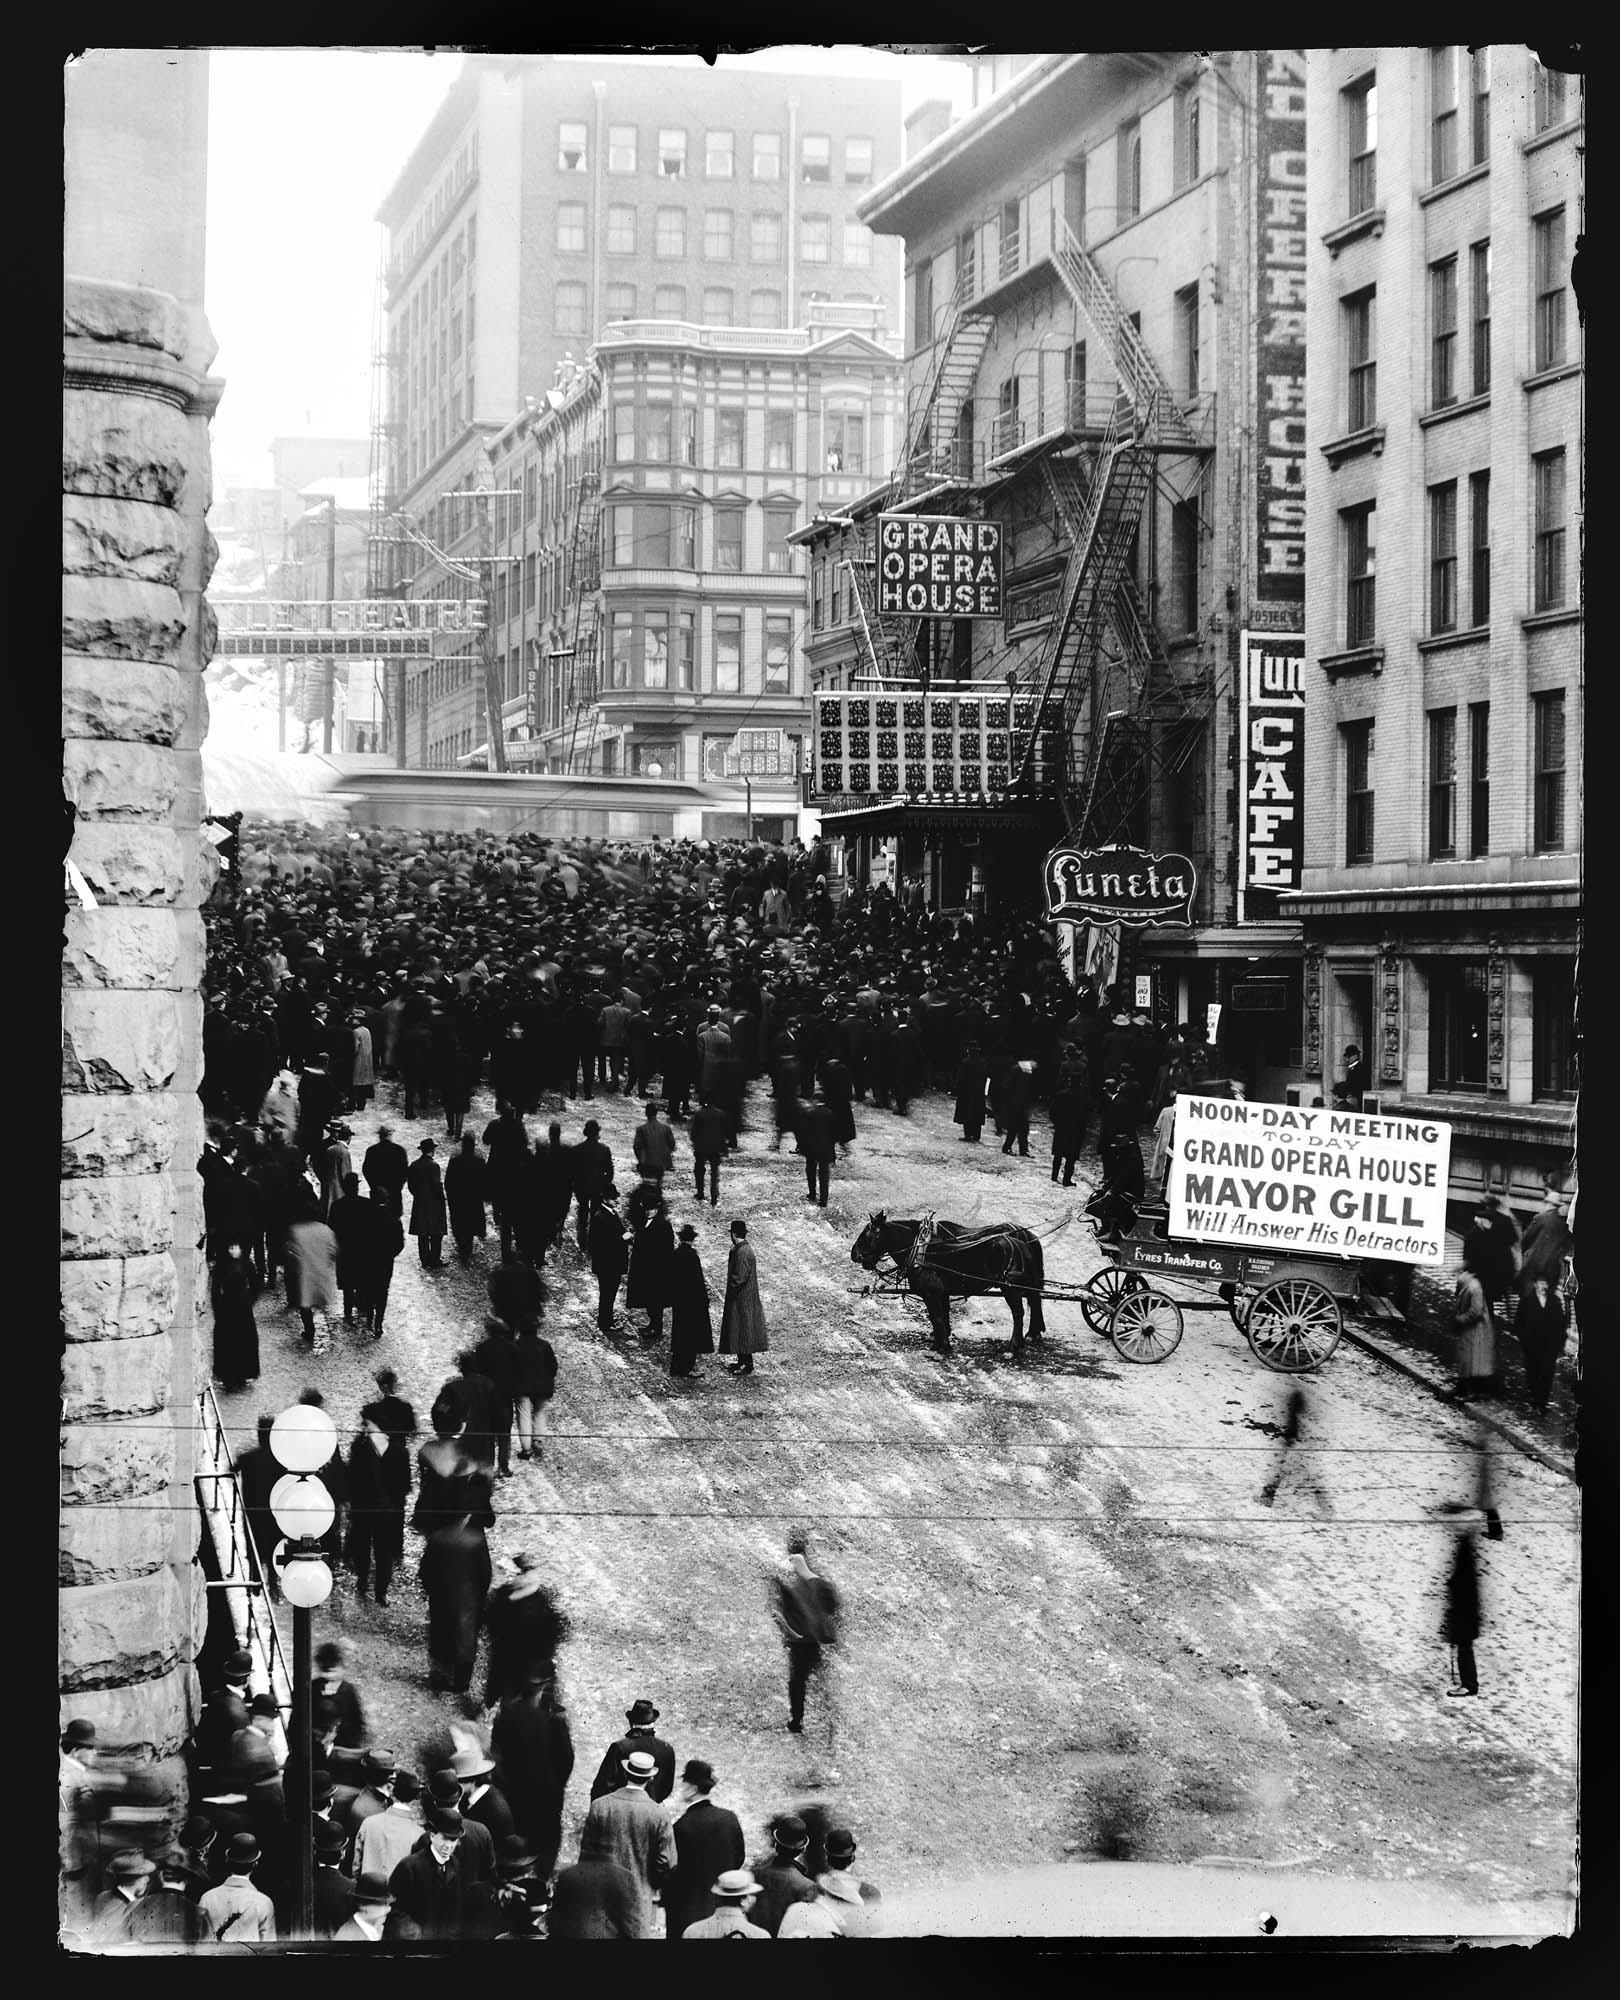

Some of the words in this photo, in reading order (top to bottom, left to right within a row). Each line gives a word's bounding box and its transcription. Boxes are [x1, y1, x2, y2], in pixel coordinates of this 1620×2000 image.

[1264, 150, 1306, 345] OPERA
[1264, 374, 1306, 574] HOUSE
[883, 521, 999, 552] GRAND
[883, 552, 998, 582] OPERA
[883, 583, 999, 613] HOUSE
[1249, 717, 1294, 884] CAFE
[1189, 1100, 1318, 1130] NOON-DAY
[1330, 1116, 1439, 1143] MEETING
[1184, 1138, 1264, 1169] GRAND
[1271, 1147, 1351, 1179] OPERA
[1359, 1156, 1437, 1187] HOUSE
[1185, 1173, 1316, 1216] MAYOR
[1329, 1189, 1424, 1228] GILL
[1186, 1208, 1228, 1233] Will
[1230, 1213, 1304, 1241] Answer
[1306, 1222, 1338, 1245] His
[1343, 1226, 1438, 1256] Detractors
[1163, 1252, 1207, 1269] TRANSFER
